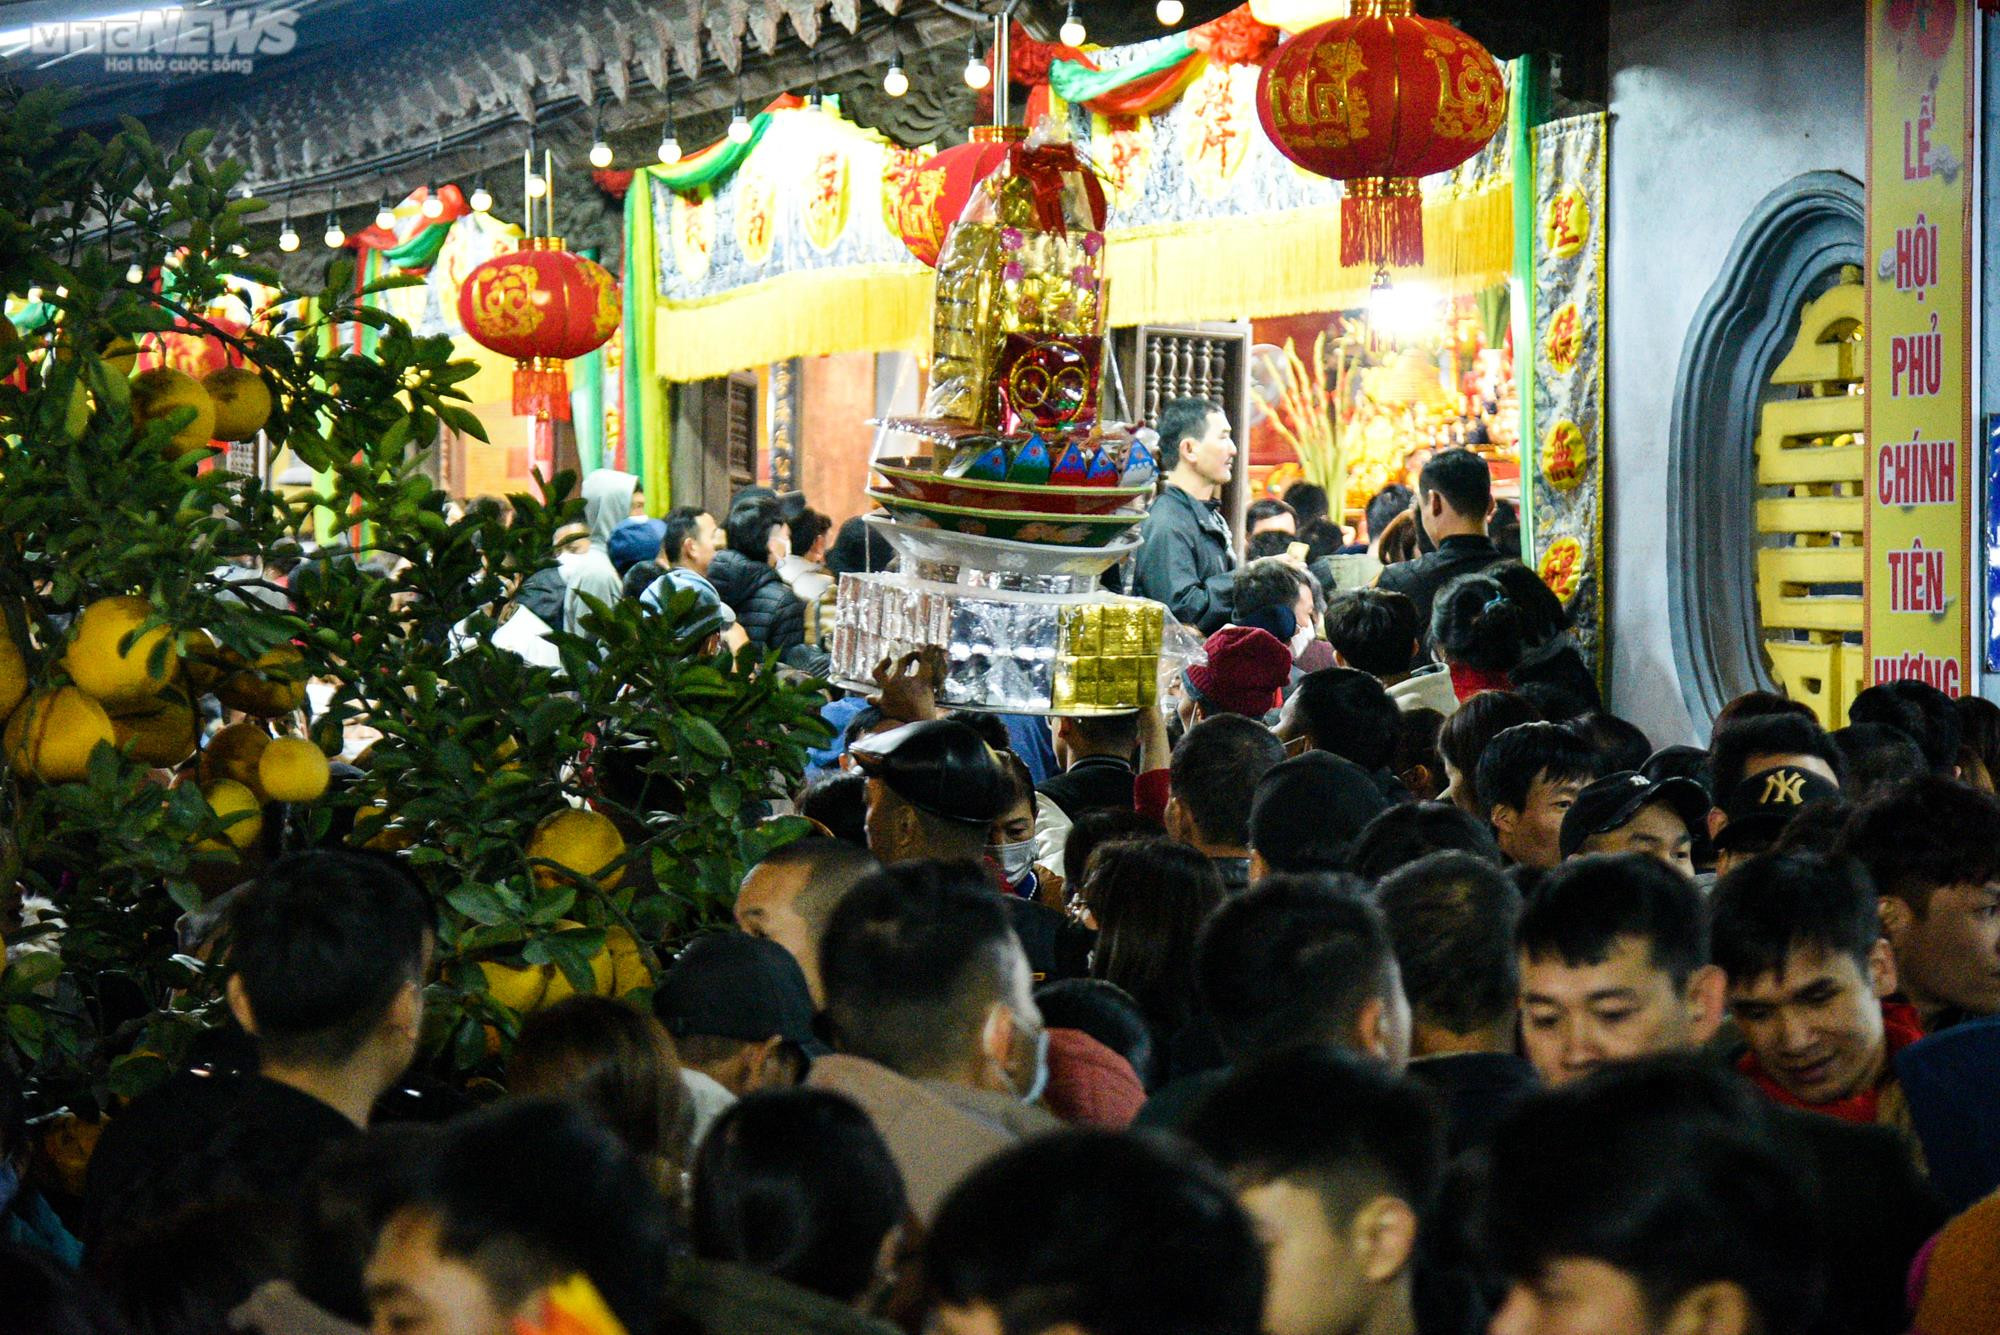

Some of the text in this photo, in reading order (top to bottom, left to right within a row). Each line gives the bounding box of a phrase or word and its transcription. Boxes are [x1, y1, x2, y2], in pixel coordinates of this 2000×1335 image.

[1903, 94, 1932, 180] LỄ
[1896, 213, 1938, 301] HỘI
[1892, 312, 1942, 397] PHỦ
[1878, 429, 1955, 505] CHÍNH
[1888, 538, 1943, 611] TIÊN
[1760, 769, 1807, 805] NY
